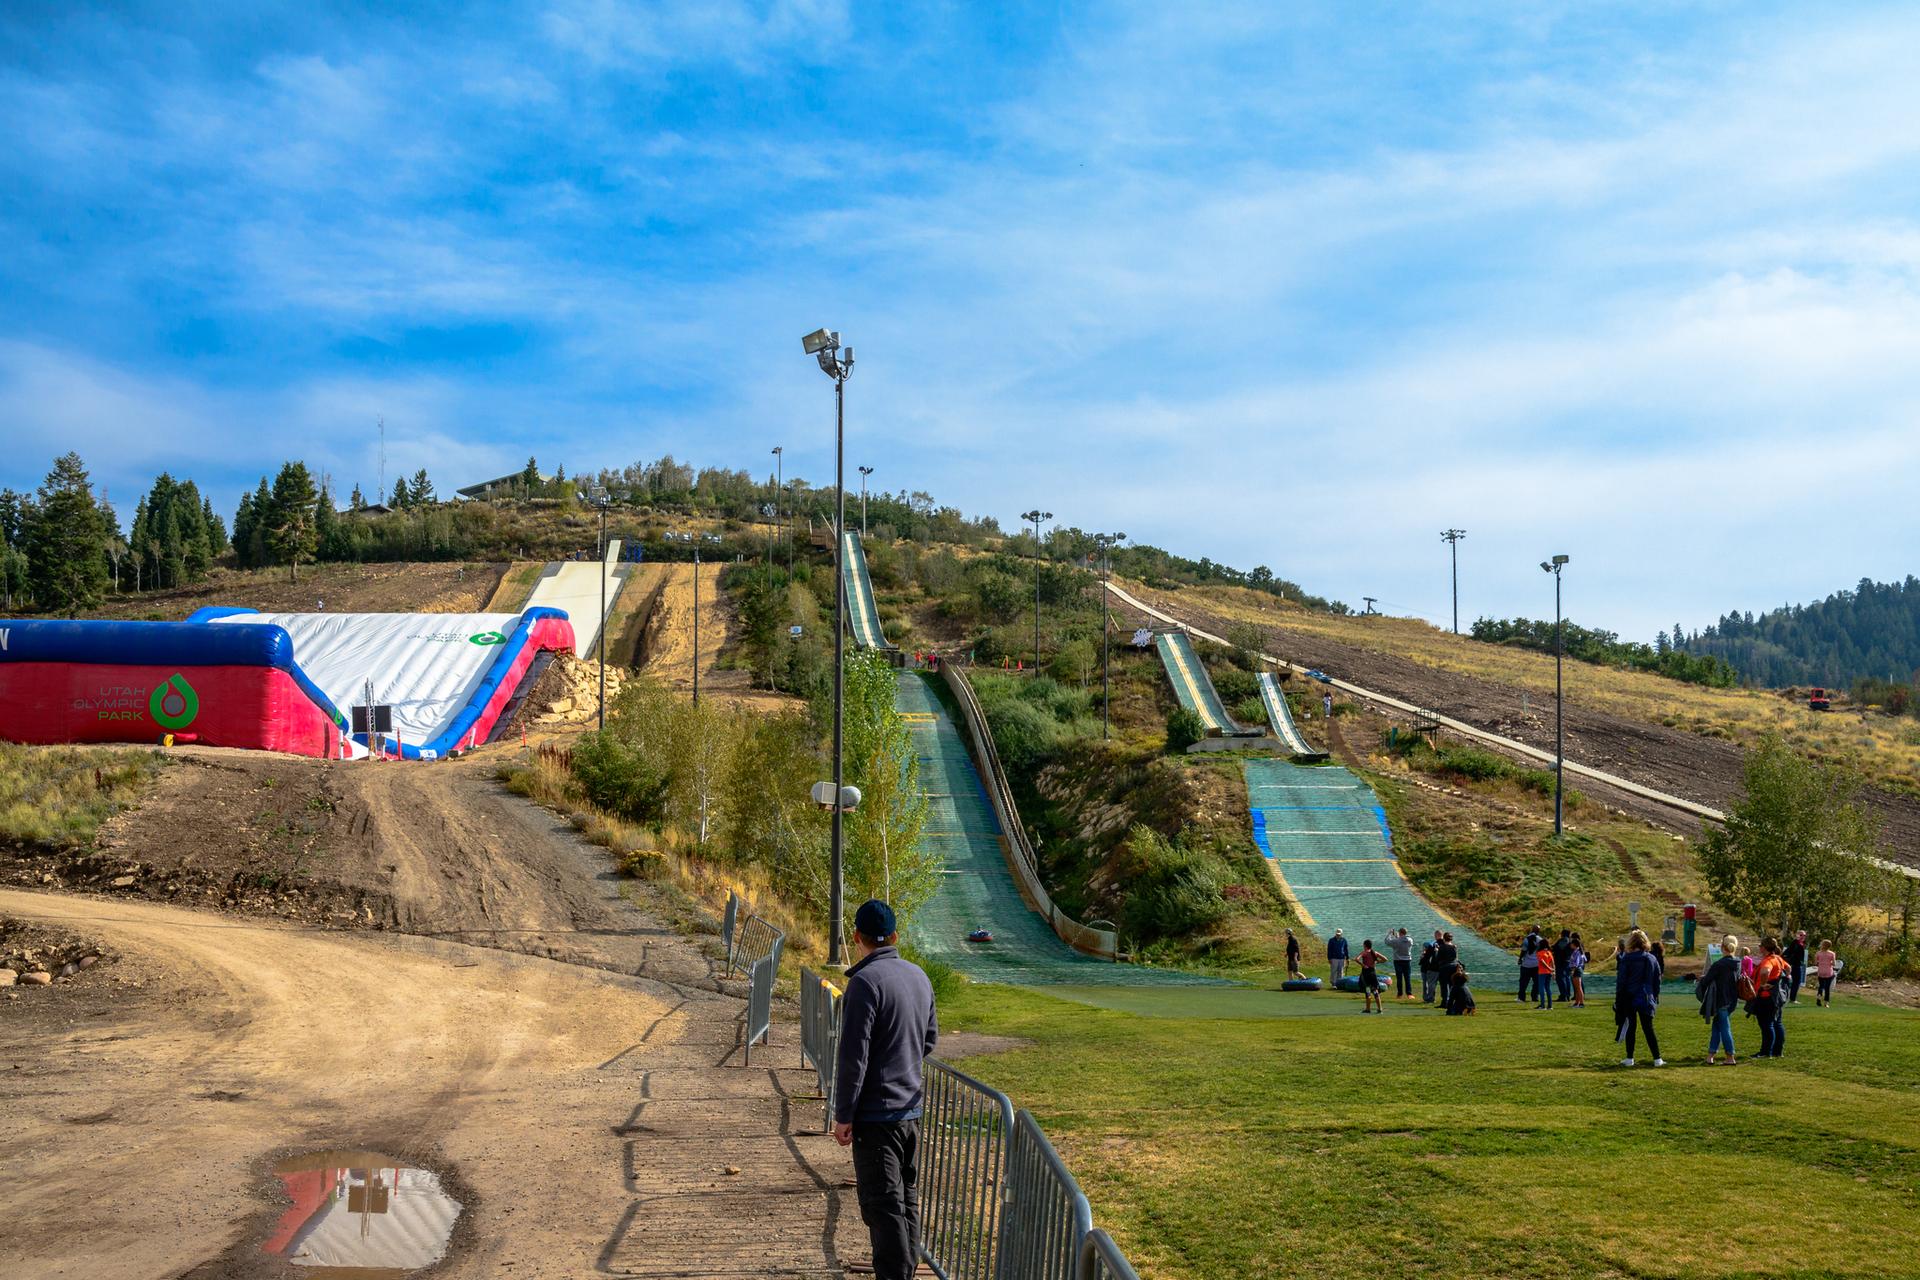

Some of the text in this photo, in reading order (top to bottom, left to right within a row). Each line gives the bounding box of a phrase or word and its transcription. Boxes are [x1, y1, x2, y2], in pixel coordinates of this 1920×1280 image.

[100, 687, 146, 697] UTAH
[73, 699, 145, 709] OLYMPIC
[98, 711, 144, 721] PARK
